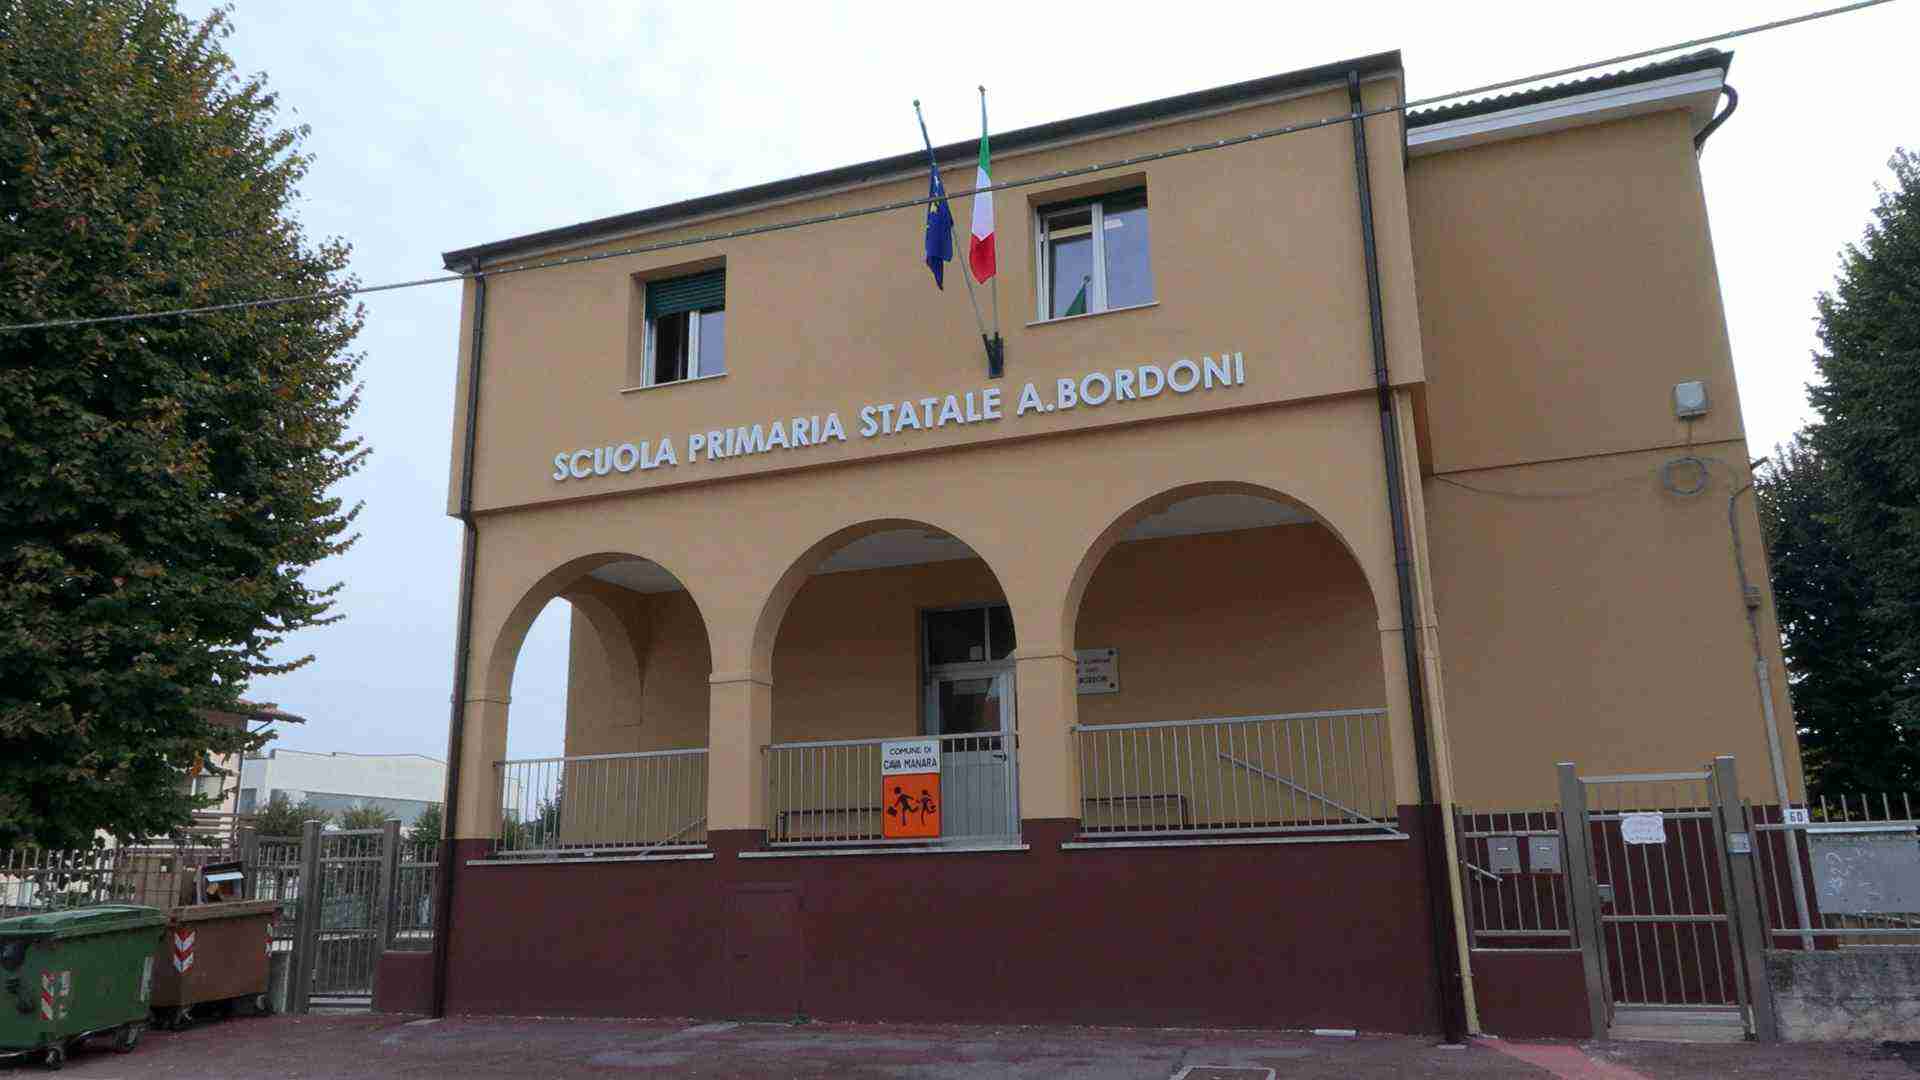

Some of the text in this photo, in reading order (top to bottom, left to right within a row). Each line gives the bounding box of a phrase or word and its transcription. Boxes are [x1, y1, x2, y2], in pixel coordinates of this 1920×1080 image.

[553, 352, 1246, 481] SCUOLA PRIMARIA STATALE A.BORDONI
[889, 745, 932, 756] COMUNE DI
[883, 757, 937, 770] CAVA MANARA
